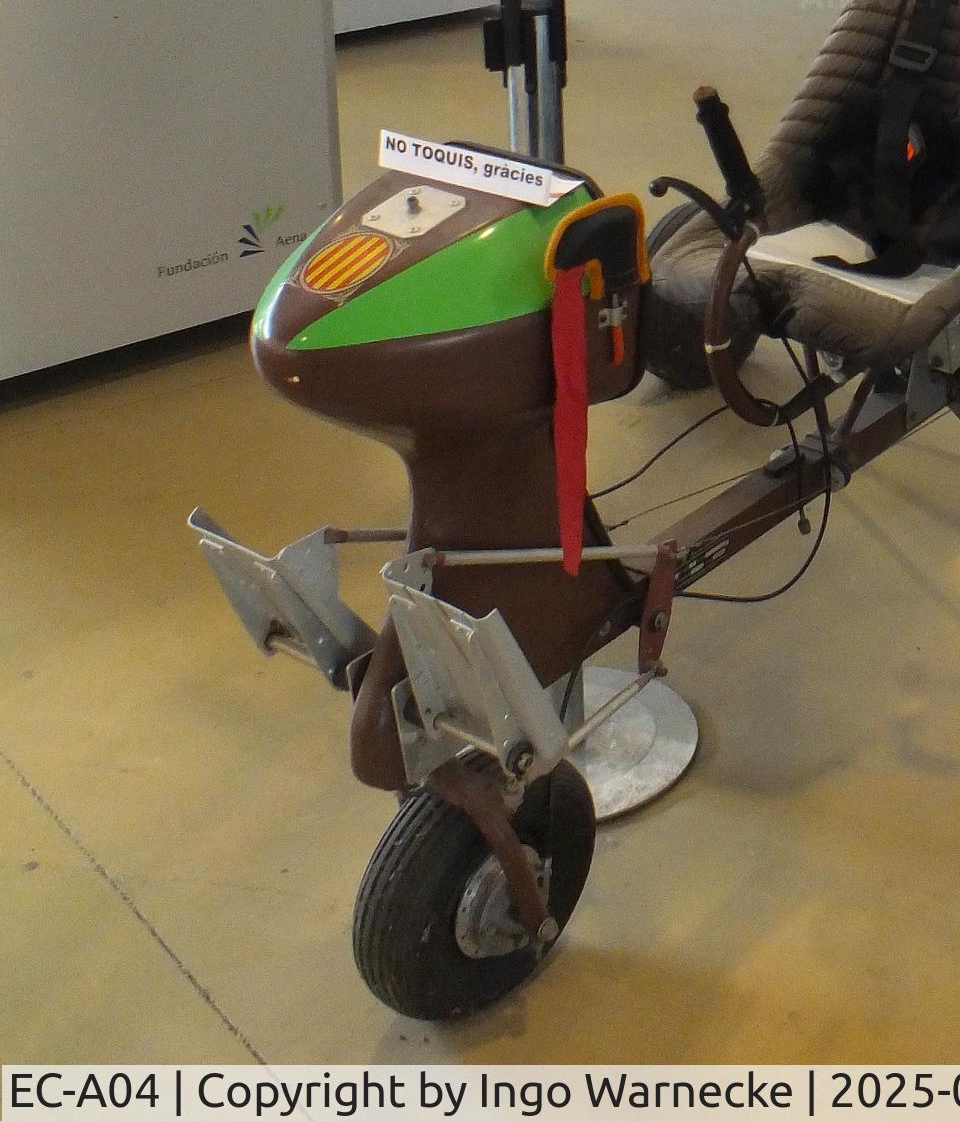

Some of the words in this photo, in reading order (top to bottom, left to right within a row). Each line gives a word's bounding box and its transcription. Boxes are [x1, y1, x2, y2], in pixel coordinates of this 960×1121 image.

[385, 135, 406, 153] NO
[412, 142, 478, 174] TOQUIS,
[483, 164, 543, 187] gràcies
[157, 250, 229, 278] Fundación
[276, 232, 308, 247] Aena
